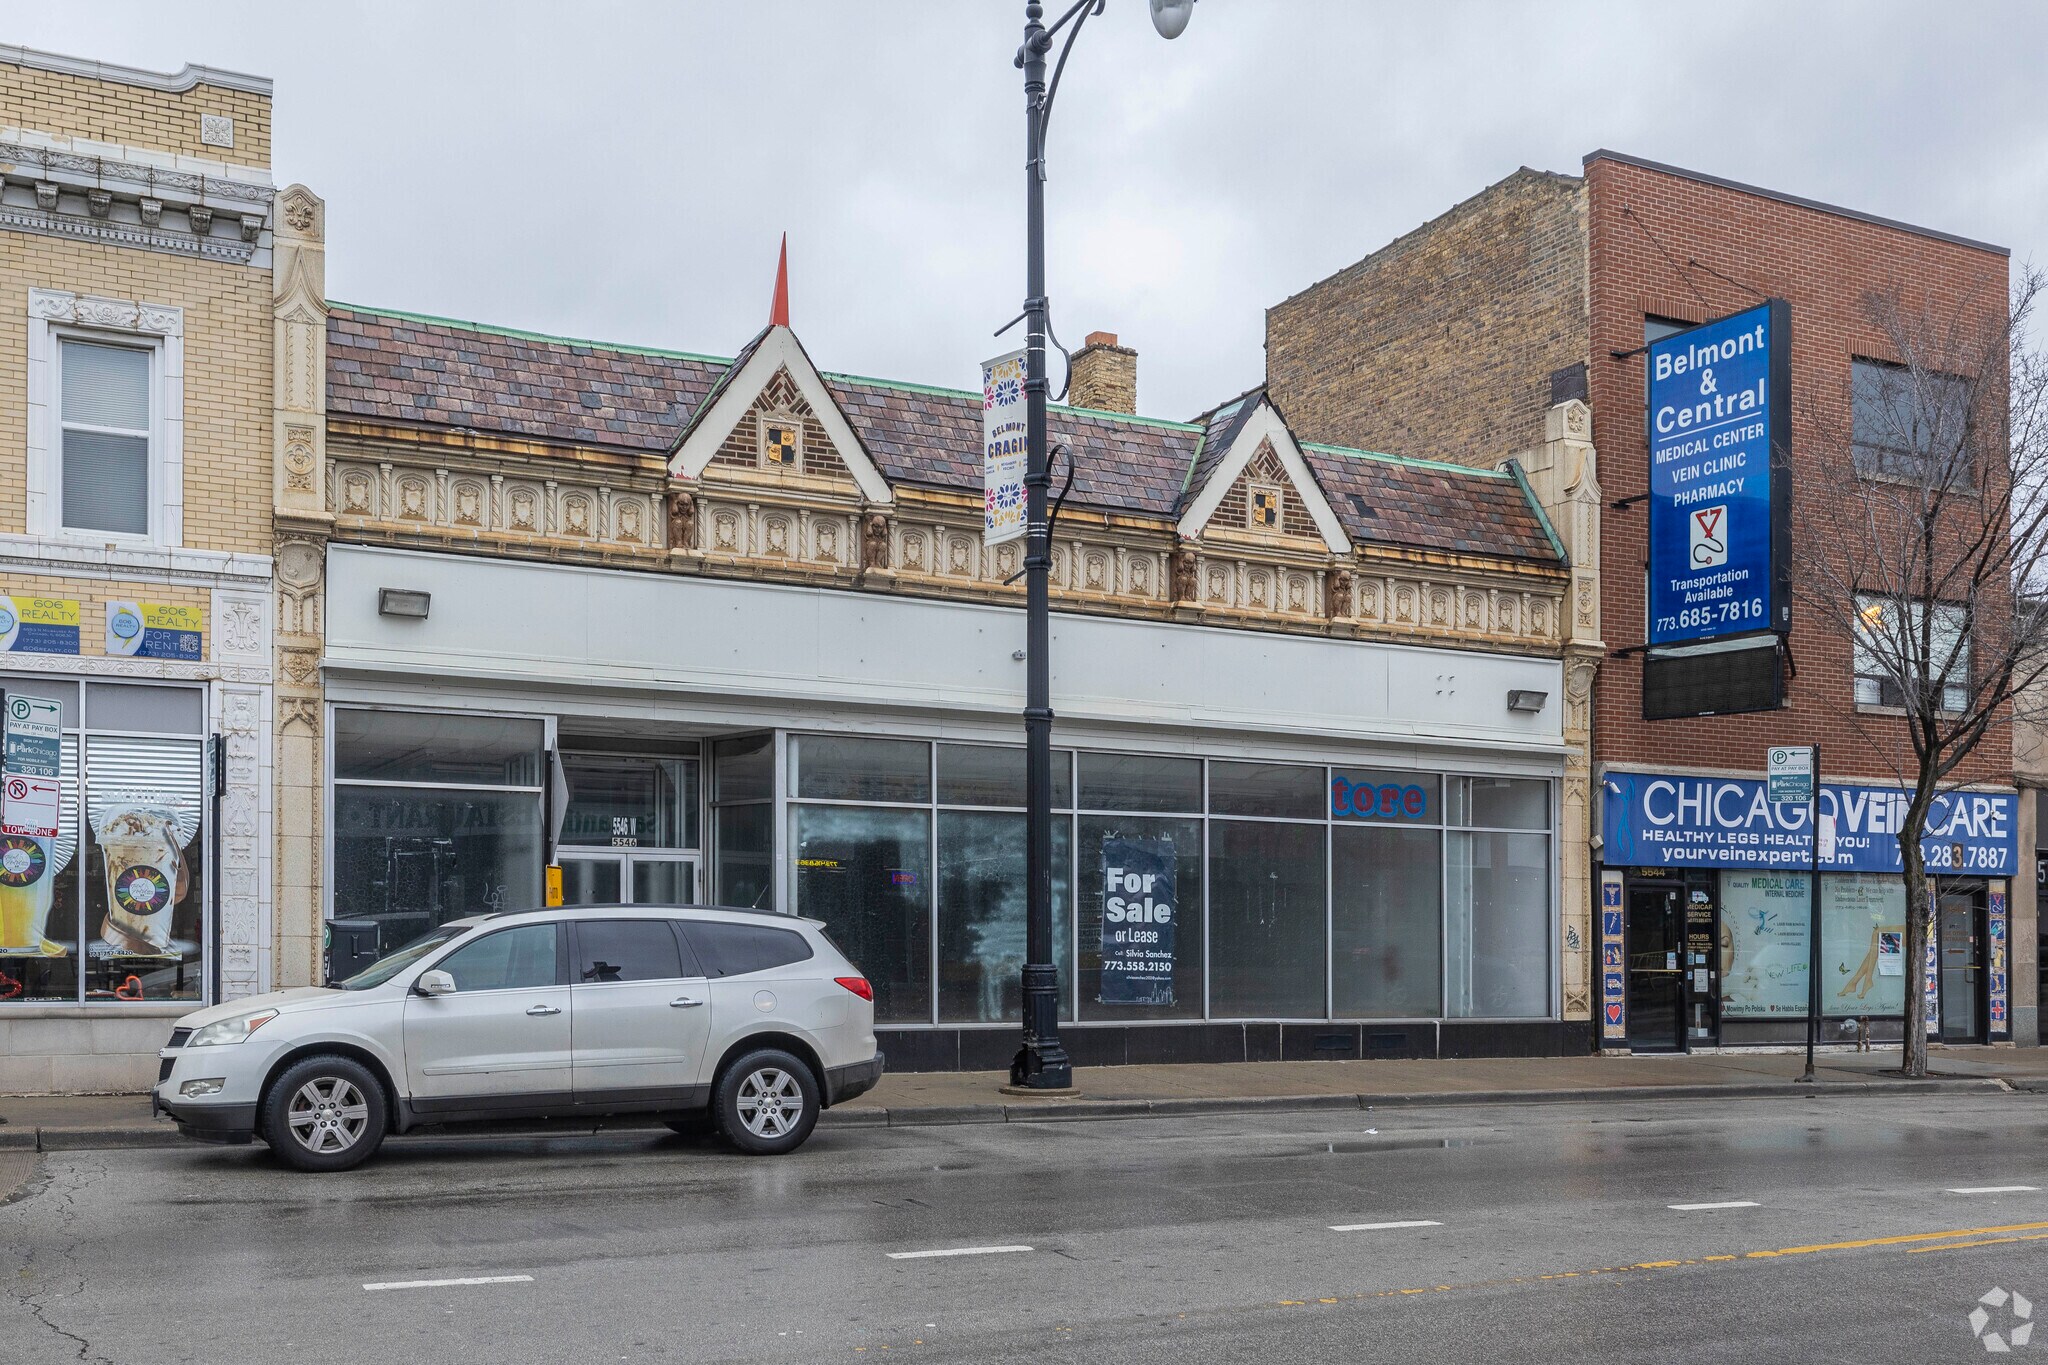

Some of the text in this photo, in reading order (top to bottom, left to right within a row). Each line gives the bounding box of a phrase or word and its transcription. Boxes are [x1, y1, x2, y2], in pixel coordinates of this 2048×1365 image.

[1656, 324, 1764, 382] Belmont
[1700, 368, 1717, 395] &
[1656, 378, 1765, 433] Central
[992, 422, 1025, 438] BELMONT
[1656, 422, 1764, 464] MEDICAL CENTER
[1672, 452, 1746, 484] VEIN CLINIC
[1674, 477, 1744, 507] PHARMACY
[1671, 568, 1749, 592] Transportation
[1685, 585, 1733, 604] Available
[33, 600, 64, 610] 606
[158, 606, 188, 617] 606
[21, 608, 76, 621] REALTY
[147, 615, 199, 628] REALTY
[1656, 597, 1763, 632] 773.685-7816
[145, 631, 171, 641] FOR
[146, 641, 180, 651] RENT
[10, 721, 21, 729] PAY
[17, 744, 58, 758] ParkChicago
[21, 765, 37, 774] 320
[39, 767, 54, 776] 106
[1924, 795, 2007, 838] CARE
[5, 825, 25, 834] TOW
[613, 817, 628, 835] 5546
[630, 817, 637, 835] W
[613, 839, 636, 847] 5546
[1642, 829, 1714, 844] HEALTHY
[1717, 832, 1759, 845] LEGS
[1835, 836, 1870, 848] YOU!
[1641, 868, 1666, 877] 5544
[1107, 867, 1156, 893] For
[1751, 878, 1783, 889] MEDICAL
[1784, 879, 1805, 890] CARE
[1765, 890, 1805, 898] INTERNAL MEDICINE
[1106, 896, 1171, 924] Sale
[1115, 928, 1158, 943] or Lease
[1126, 949, 1144, 958] Silvia
[1145, 950, 1172, 959] Sanchez
[1104, 960, 1172, 972] 773.558.2150
[1726, 1004, 1744, 1014] Mowimy
[1745, 1004, 1751, 1012] Po
[1751, 1004, 1766, 1012] Polsku
[1776, 1004, 1782, 1012] Se
[1782, 1004, 1794, 1012] Habla
